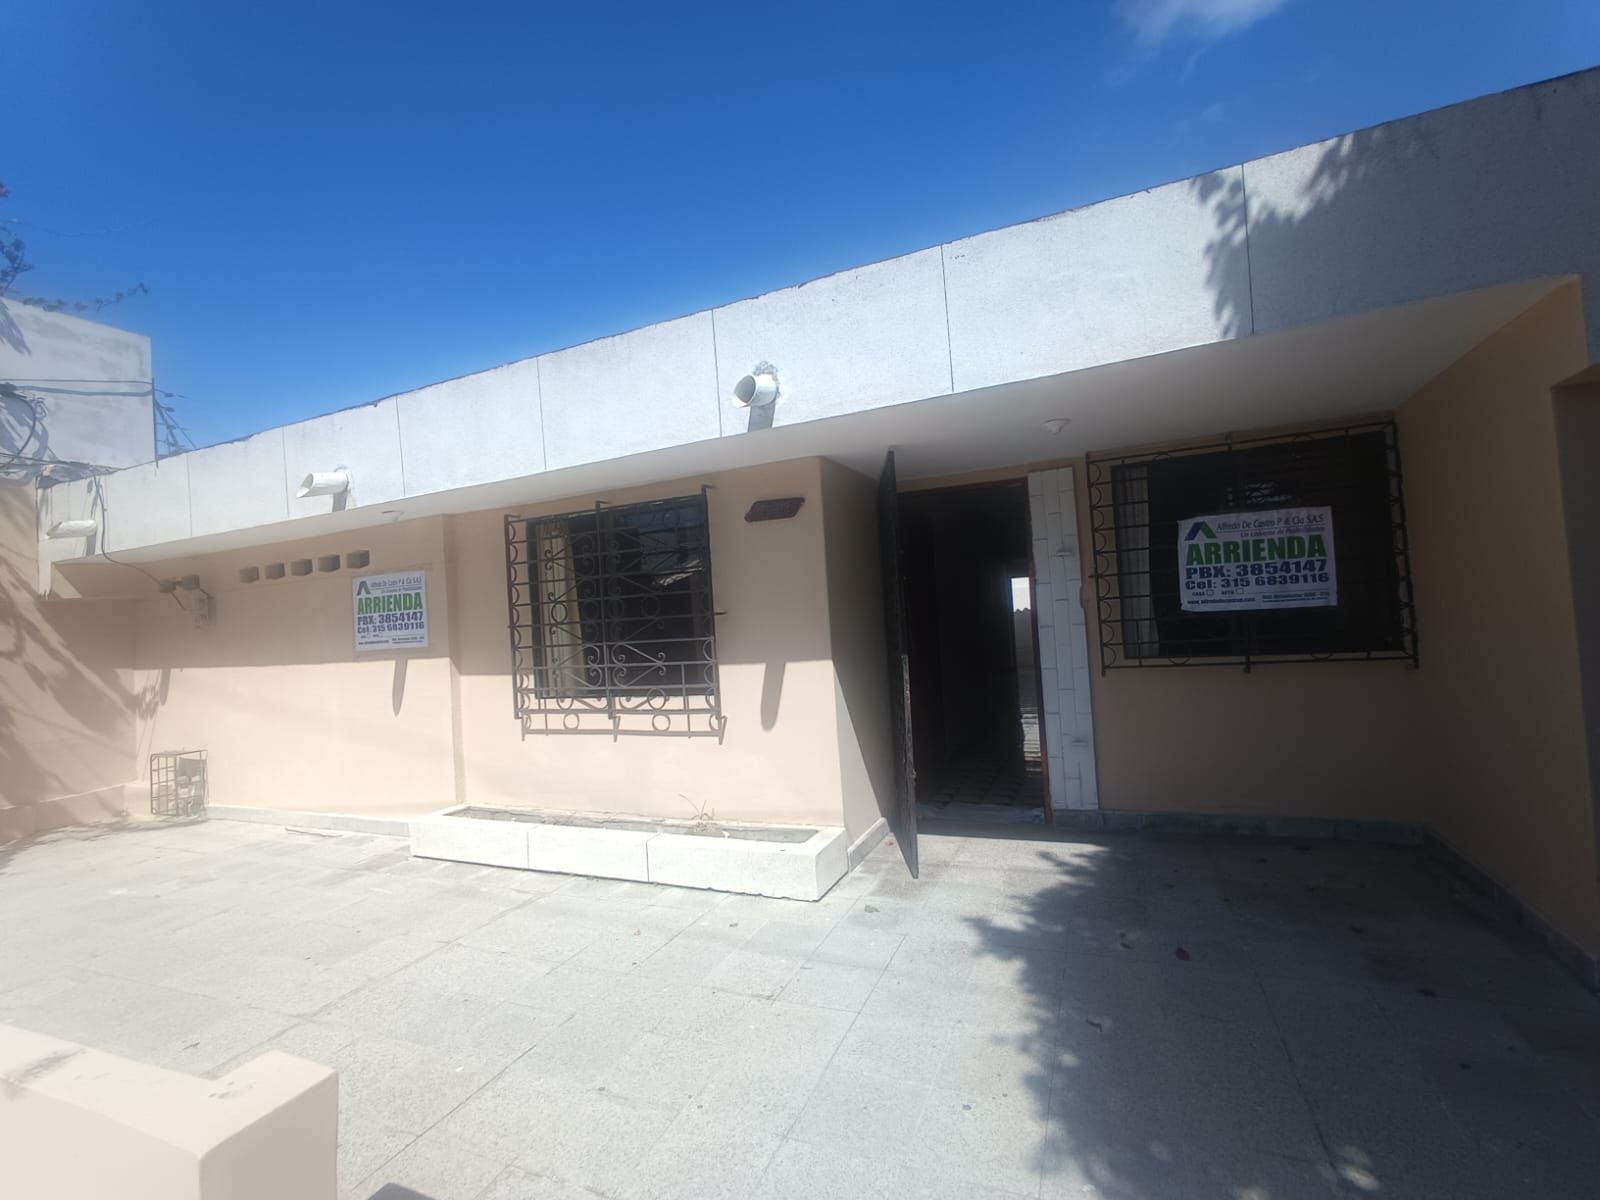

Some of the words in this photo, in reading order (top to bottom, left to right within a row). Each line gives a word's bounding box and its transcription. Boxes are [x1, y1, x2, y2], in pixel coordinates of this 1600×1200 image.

[1242, 520, 1251, 529] De
[1186, 534, 1328, 567] ARRIENDA
[1186, 566, 1231, 579] PBX:
[1236, 559, 1328, 577] 3854147
[1185, 580, 1217, 590] Cel:
[1221, 577, 1250, 588] 315
[1255, 572, 1329, 586] 6839116
[357, 592, 423, 615] ARRIENDA
[357, 615, 377, 626] PBX:
[378, 611, 424, 624] 3854147
[372, 624, 385, 633] 315
[386, 621, 425, 632] 6839116
